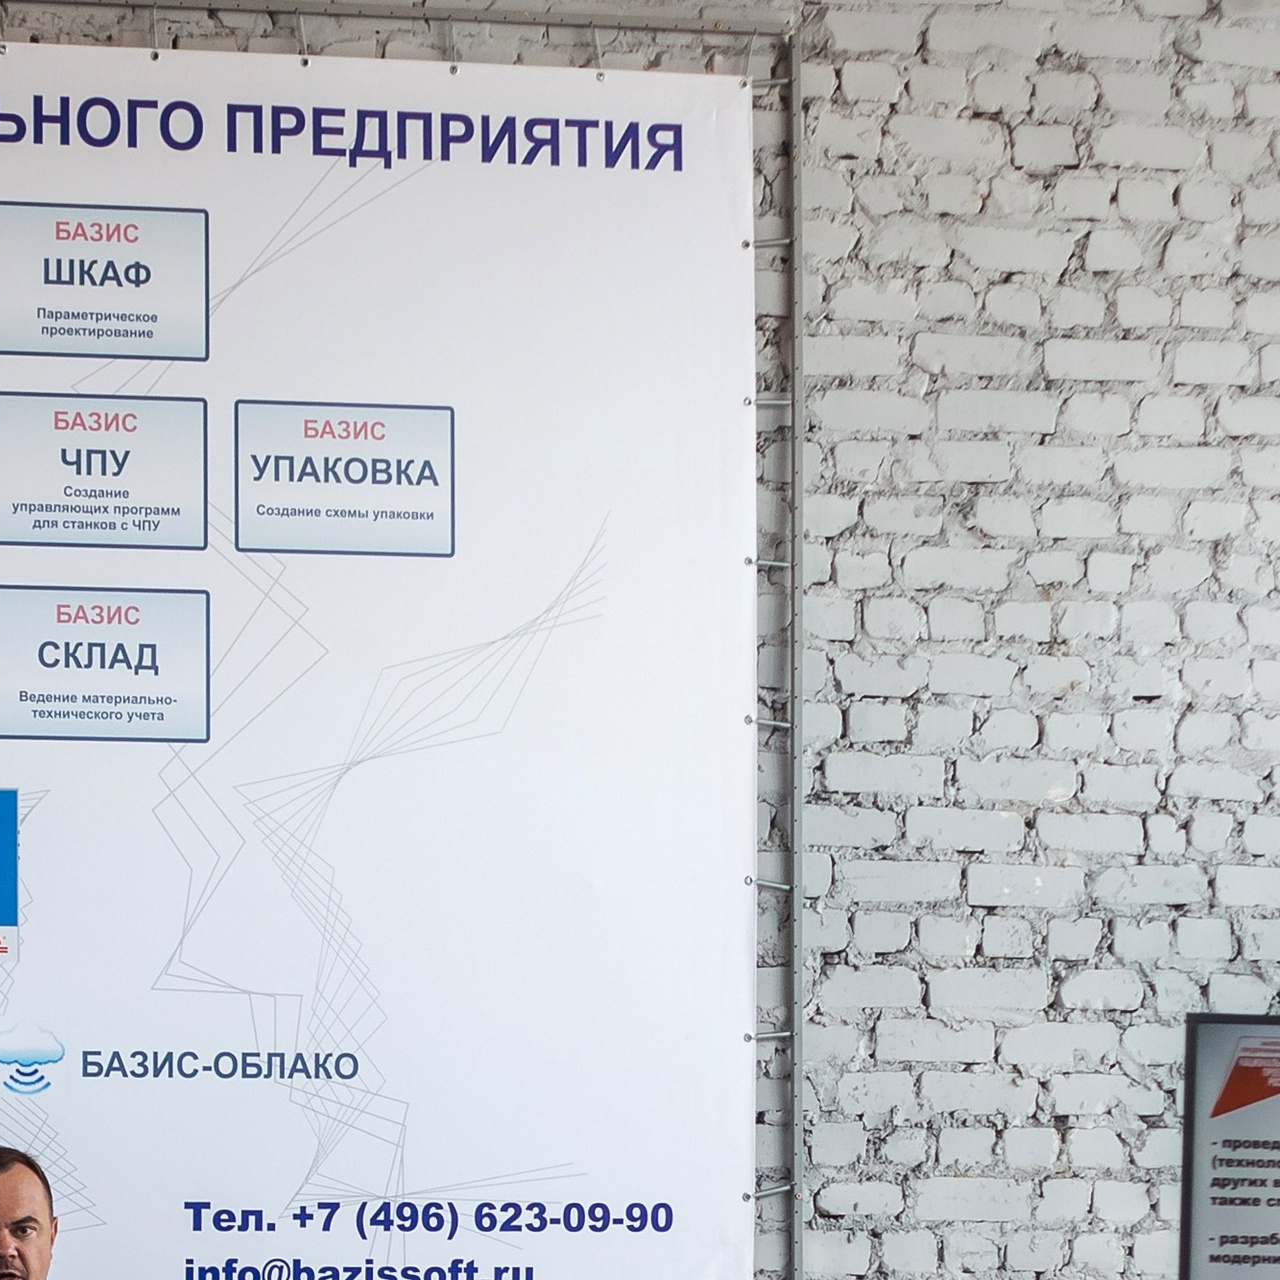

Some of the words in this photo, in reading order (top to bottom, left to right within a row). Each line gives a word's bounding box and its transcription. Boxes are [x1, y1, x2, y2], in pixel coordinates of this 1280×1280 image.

[227, 104, 682, 171] ПРЕДПРИЯТИЯ
[56, 221, 138, 243] БАЗИС
[44, 258, 151, 287] ШКАФ
[37, 308, 157, 324] Параметрическое
[41, 323, 154, 339] проектирование
[55, 411, 137, 432] БАЗИС
[304, 420, 385, 440] БАЗИС
[61, 449, 130, 476] ЧПУ
[251, 455, 439, 486] УПАКОВКА
[63, 485, 130, 500] Создание
[11, 502, 110, 516] управляющих
[114, 506, 181, 518] программ
[256, 503, 322, 518] Создание
[325, 508, 369, 519] схемы
[372, 510, 434, 522] упаковки
[31, 519, 59, 530] для
[62, 520, 117, 531] станков
[120, 521, 129, 531] с
[132, 519, 161, 532] ЧПУ
[57, 605, 139, 625] БАЗИС
[38, 641, 158, 675] СКЛАД
[19, 690, 78, 705] Ведение
[81, 694, 178, 707] материально-
[31, 709, 123, 721] технического
[126, 711, 165, 724] учета
[82, 1051, 358, 1079] БАЗИС-ОБЛАКО
[1210, 1177, 1268, 1191] других
[1210, 1196, 1262, 1207] также
[184, 1202, 275, 1231] Тел.
[293, 1202, 340, 1231] +7
[356, 1202, 458, 1240] (496)
[475, 1202, 673, 1232] 623-09-90
